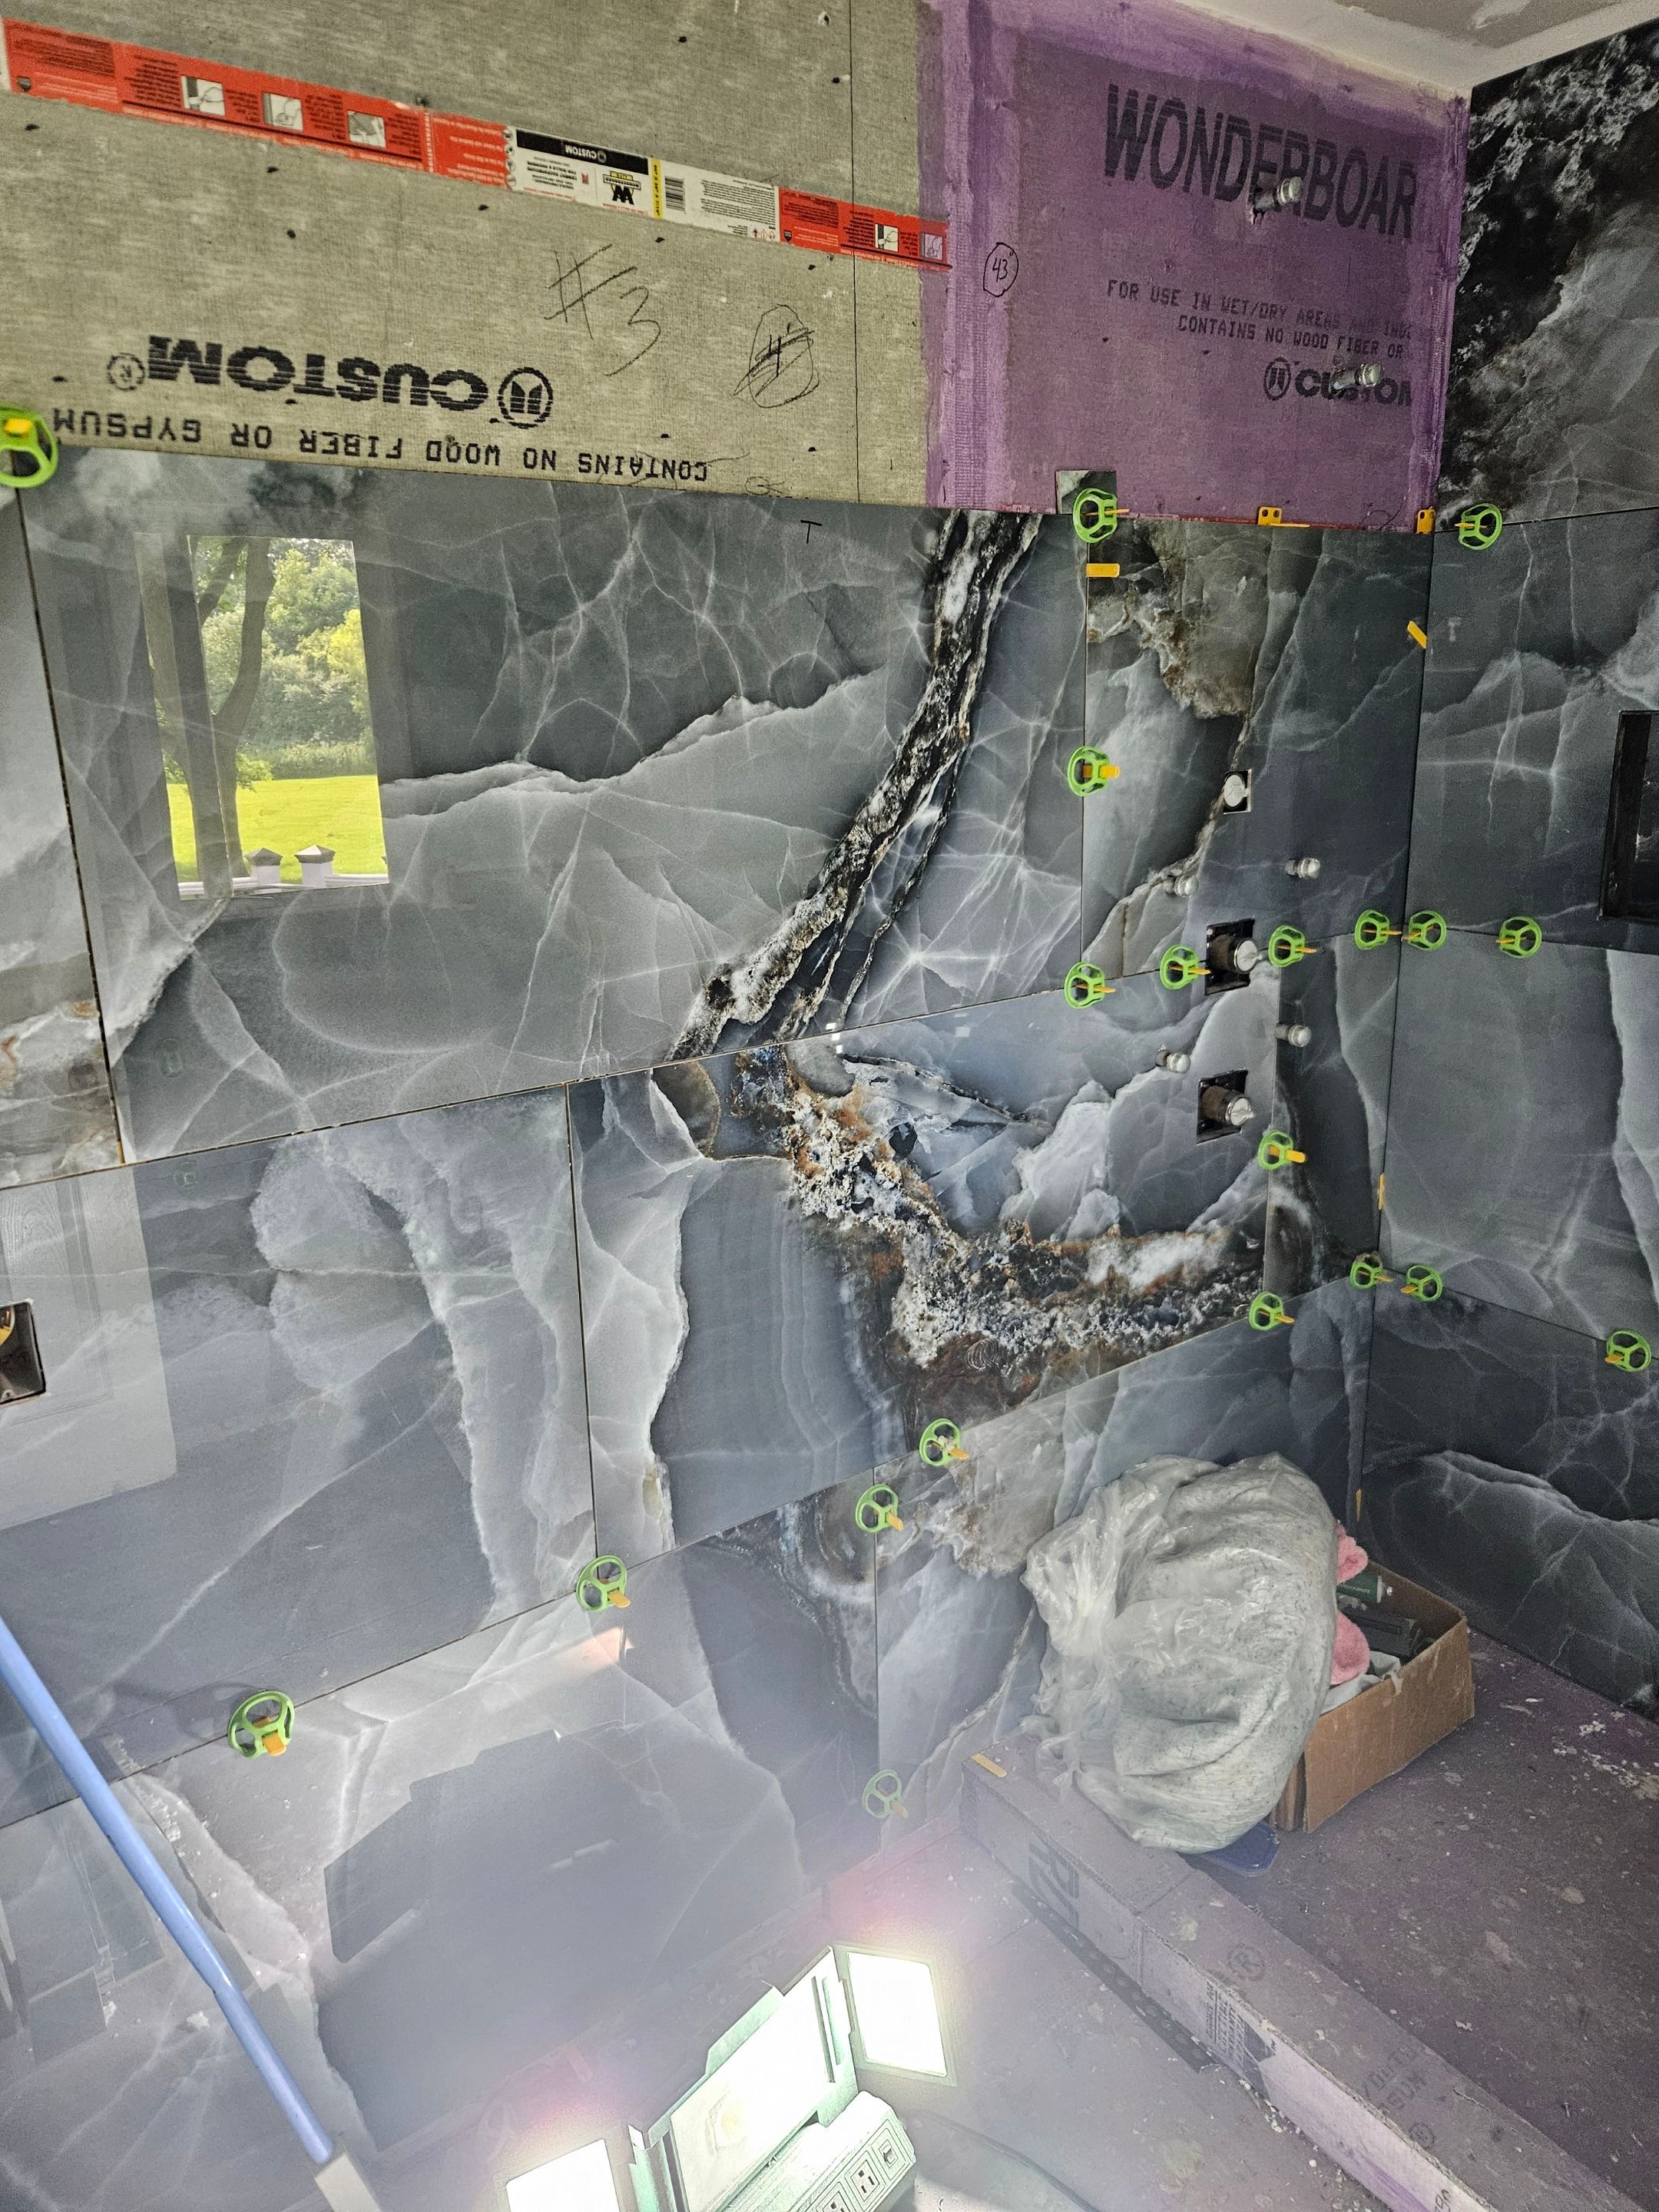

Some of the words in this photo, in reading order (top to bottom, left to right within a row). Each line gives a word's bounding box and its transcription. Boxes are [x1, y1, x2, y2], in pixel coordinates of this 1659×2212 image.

[565, 144, 597, 160] CUSTOM
[545, 243, 662, 376] #3
[1107, 279, 1140, 301] FOR
[1150, 285, 1182, 306] USE
[1192, 291, 1212, 311] IN
[1220, 295, 1288, 322] WET/DRY
[1177, 314, 1257, 340] CONTAINS
[1265, 326, 1284, 344] NO
[1293, 330, 1329, 350] WOOD
[1336, 336, 1379, 356] FIBER
[1387, 343, 1404, 359] OR
[148, 335, 489, 411] CUSTOM
[52, 408, 202, 442] GYPSUM
[230, 422, 273, 449] OR
[299, 429, 403, 460] FIBER
[426, 440, 501, 466] WOOD
[523, 447, 557, 472] NO
[578, 452, 707, 482] CONTAINS
